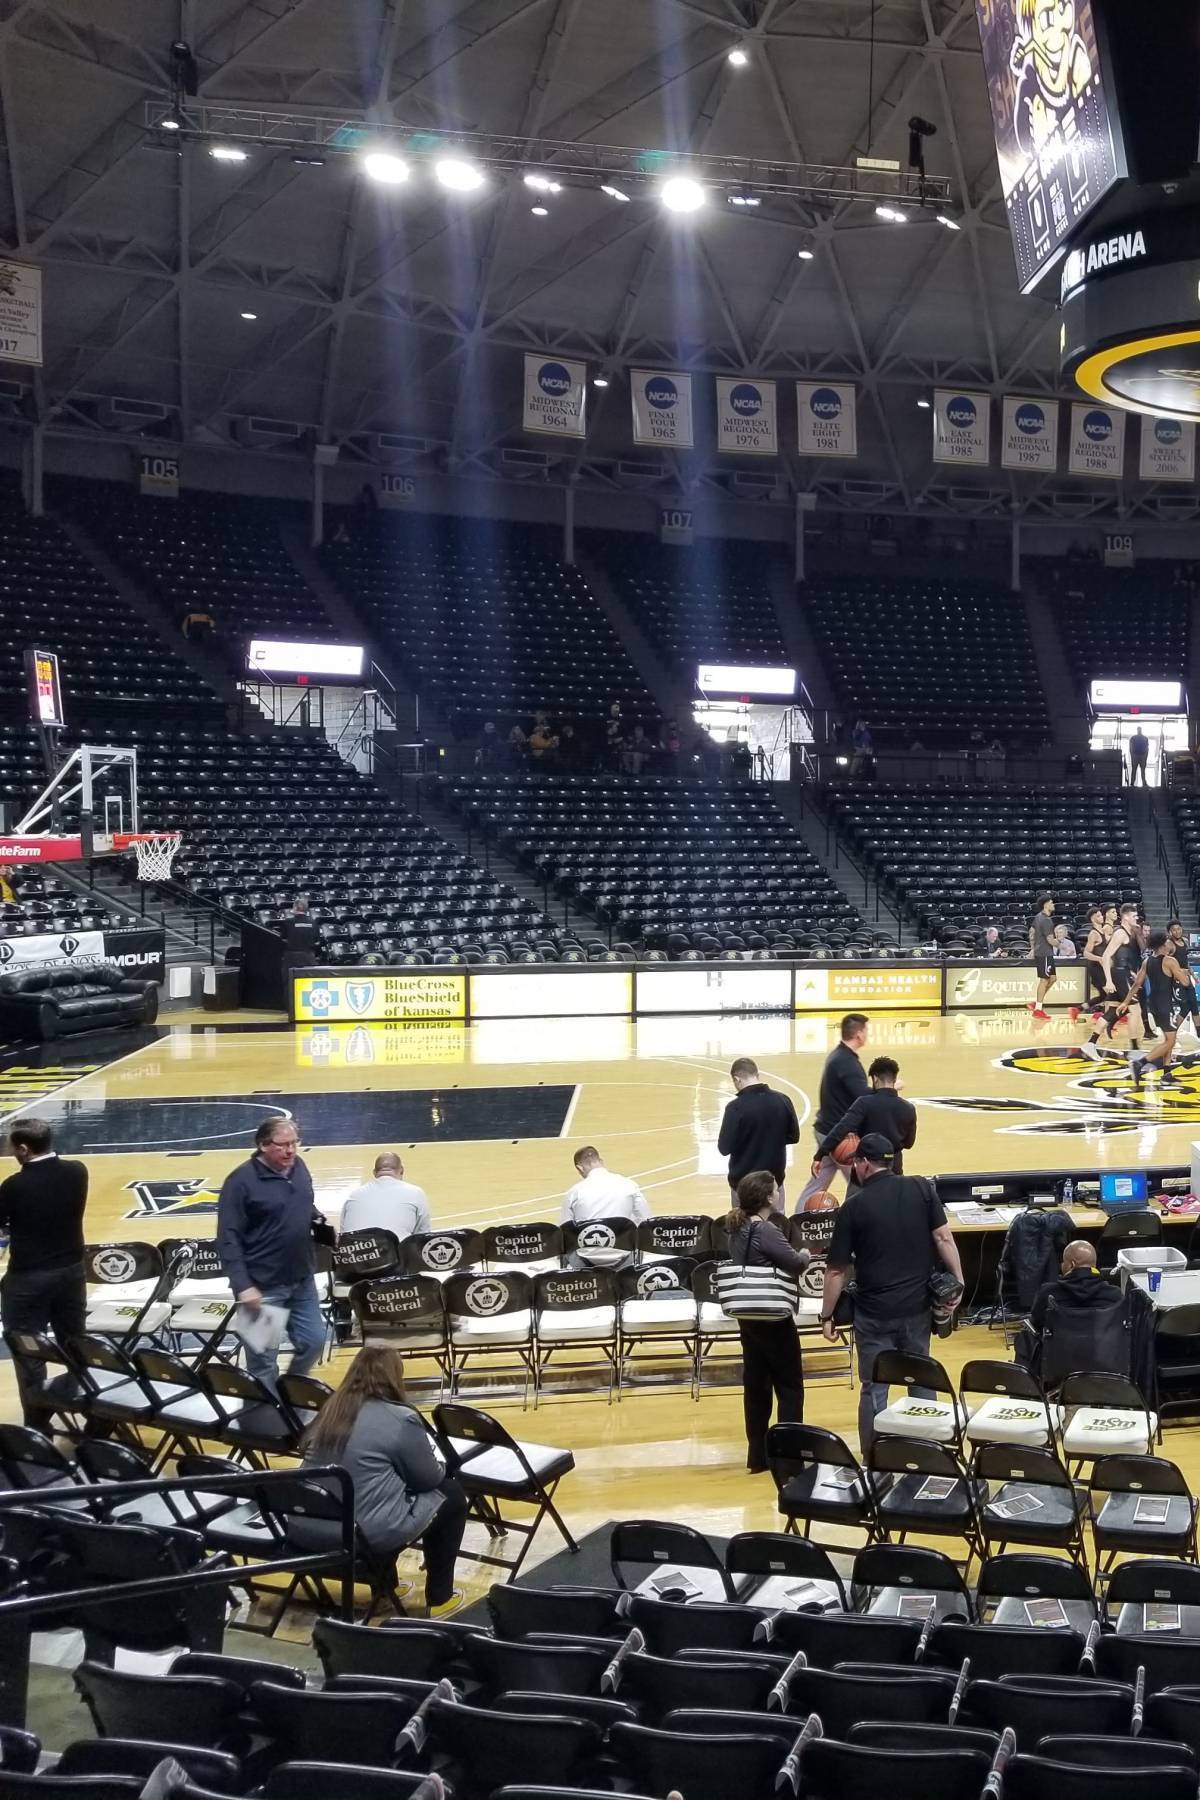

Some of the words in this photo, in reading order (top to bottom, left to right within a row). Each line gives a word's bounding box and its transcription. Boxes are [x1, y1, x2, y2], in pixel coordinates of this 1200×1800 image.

[1087, 231, 1146, 273] ARENA
[540, 376, 570, 389] NCAA
[648, 391, 678, 401] NCAA
[529, 402, 580, 416] REGIONAL
[733, 399, 762, 409] NCAA
[813, 403, 841, 412] NCAA
[542, 414, 567, 428] 1964
[950, 411, 976, 421] NCAA
[725, 418, 768, 427] MIDWEST
[1018, 418, 1045, 427] NCAA
[651, 427, 676, 438] 1965
[723, 425, 771, 435] REGIONAL
[1086, 424, 1111, 434] NCAA
[736, 435, 759, 446] 1976
[817, 438, 839, 449] 1981
[939, 436, 984, 446] REGIONAL
[950, 445, 973, 456] 1985
[1018, 452, 1040, 463] 1987
[1085, 458, 1107, 469] 1988
[142, 457, 178, 479] 105
[383, 475, 415, 494] 106
[662, 511, 692, 528] 107
[1106, 536, 1133, 551] 109
[384, 978, 455, 991] BlueCross
[834, 975, 884, 985] KANSAS
[888, 975, 936, 985] HEALTH
[834, 986, 912, 994] FOUNDATION
[982, 980, 1035, 994] EQUITY
[1049, 980, 1078, 991] ANK
[384, 992, 461, 1003] BlueShield
[384, 1005, 398, 1016] of
[403, 1005, 451, 1016] Kansas
[652, 1224, 698, 1241] Capitol
[495, 1232, 542, 1248] Capitol
[652, 1236, 697, 1249] Federal
[496, 1242, 543, 1256] Federal
[333, 1248, 380, 1264] Federal
[546, 1278, 598, 1294] Capitol
[366, 1287, 419, 1303] Capitol
[547, 1290, 598, 1304] Federal
[369, 1297, 421, 1313] Federal
